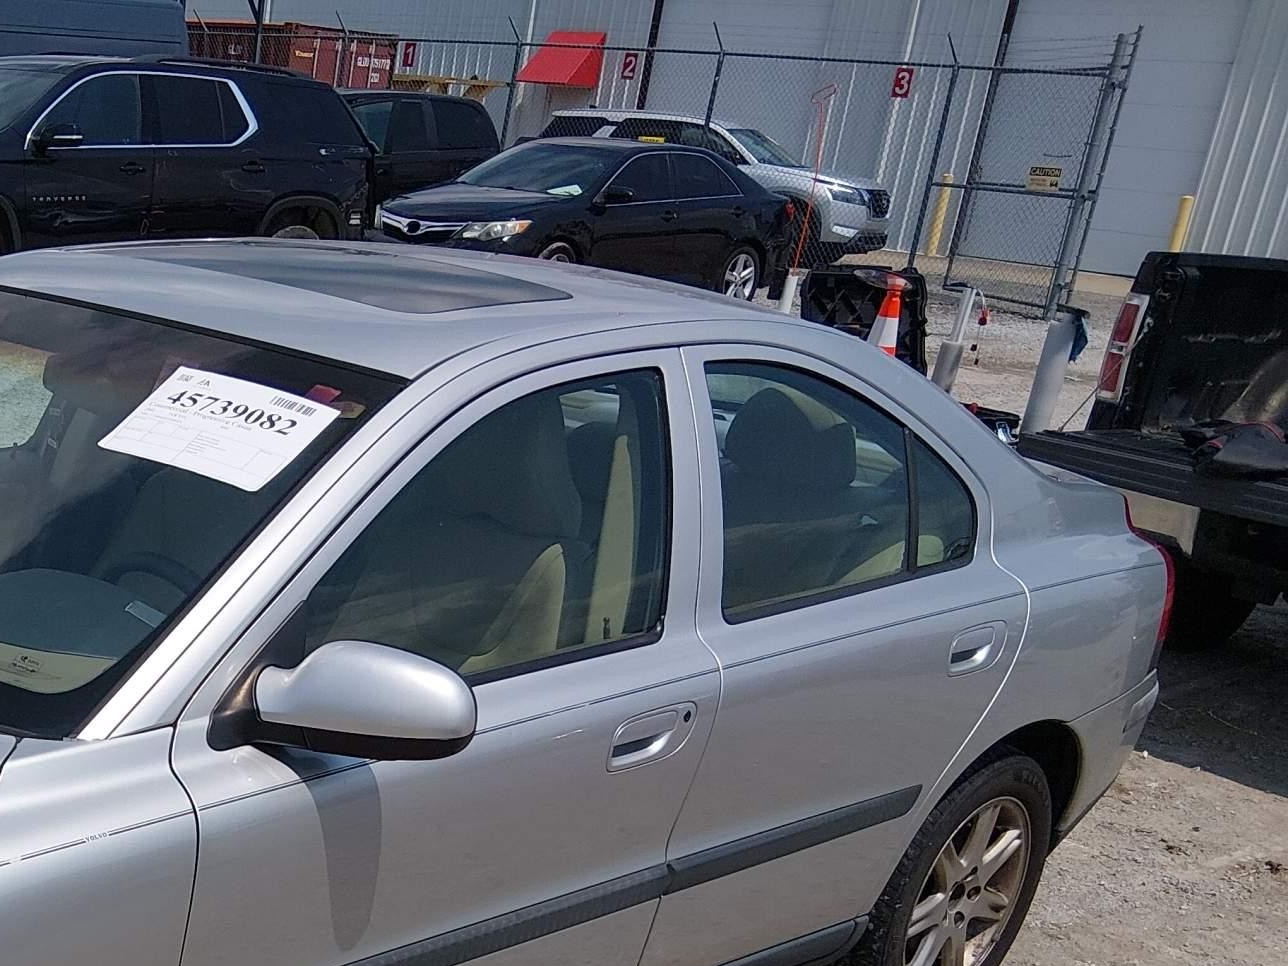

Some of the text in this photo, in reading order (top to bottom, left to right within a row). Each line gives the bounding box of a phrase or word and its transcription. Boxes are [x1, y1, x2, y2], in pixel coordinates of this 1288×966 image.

[406, 45, 414, 65] 1
[623, 56, 636, 77] 2
[894, 71, 910, 95] 3
[1031, 167, 1061, 177] CAUTION
[167, 390, 298, 436] 45739082
